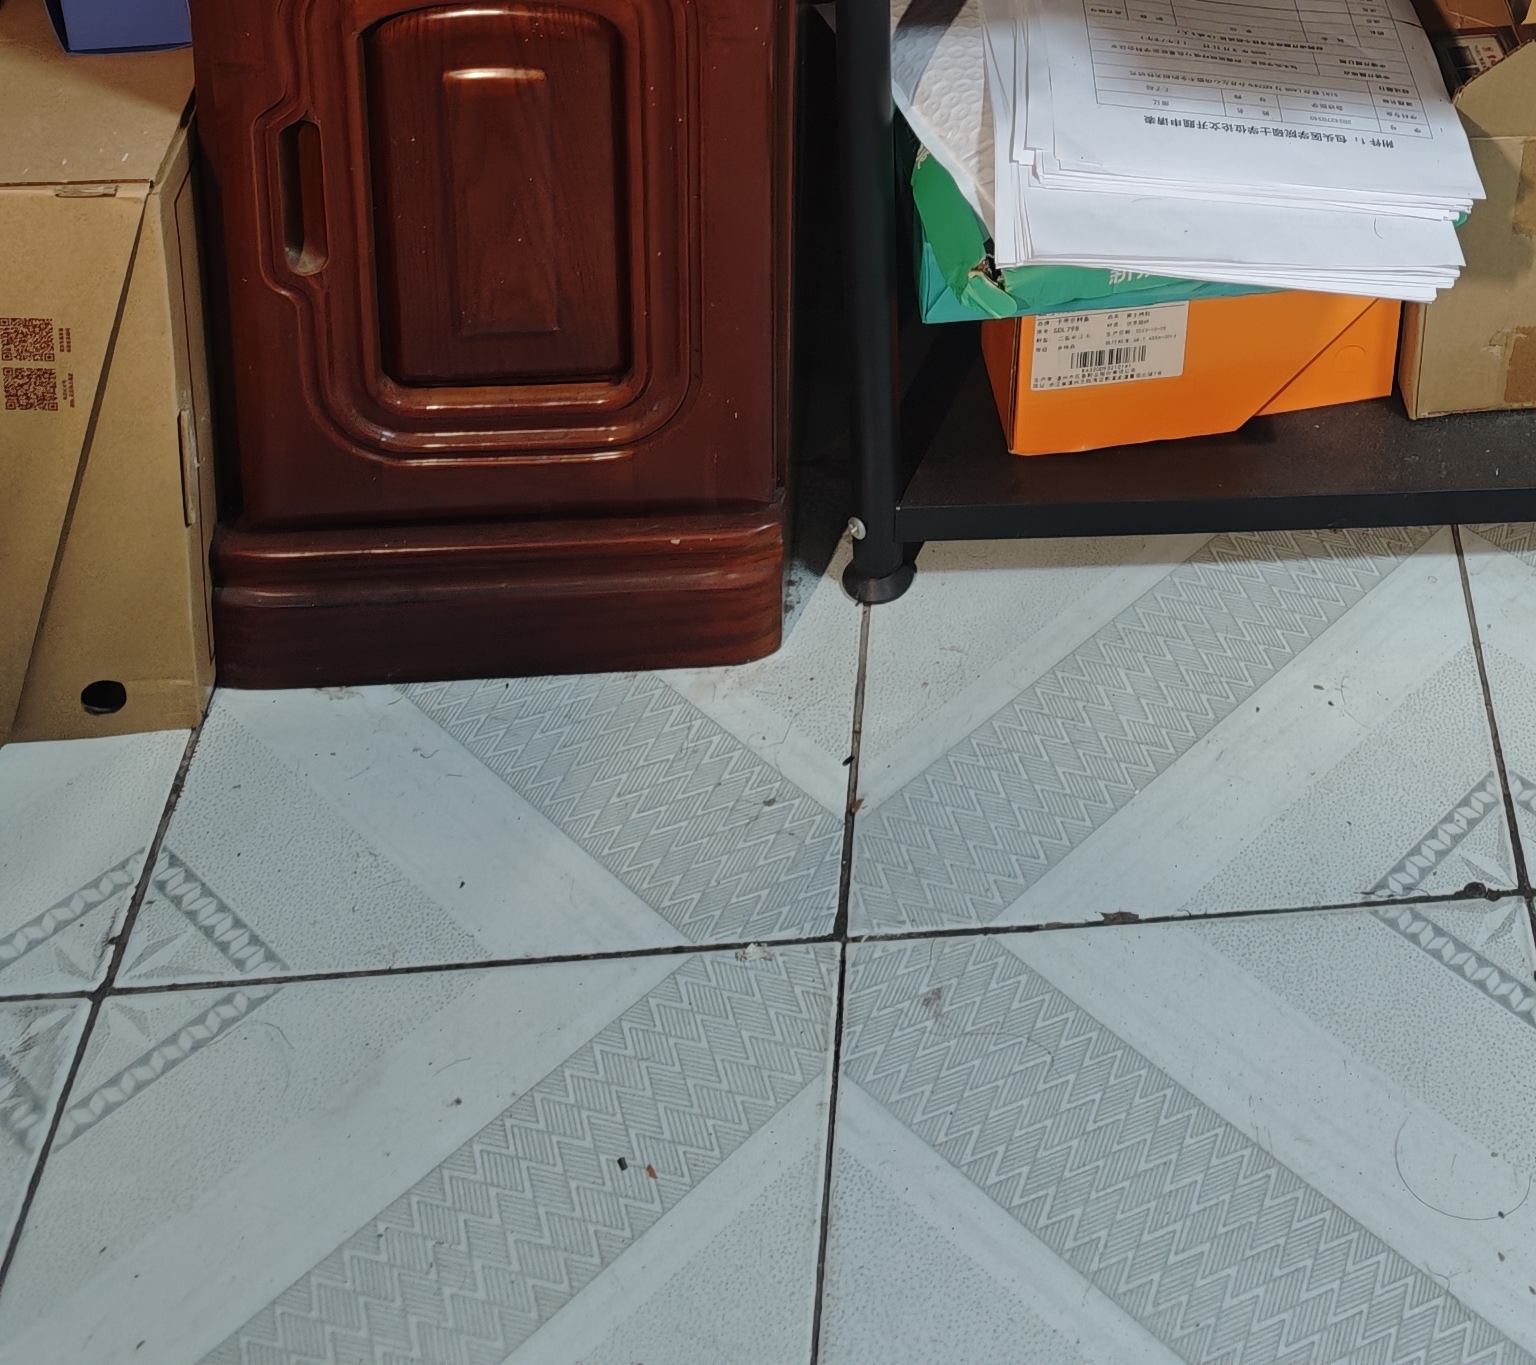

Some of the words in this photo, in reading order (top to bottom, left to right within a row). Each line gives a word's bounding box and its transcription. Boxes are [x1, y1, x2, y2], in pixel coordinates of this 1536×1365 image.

[1143, 114, 1348, 146] 包头医学院硕士学位论文开题申请表
[1366, 137, 1395, 150] 附件
